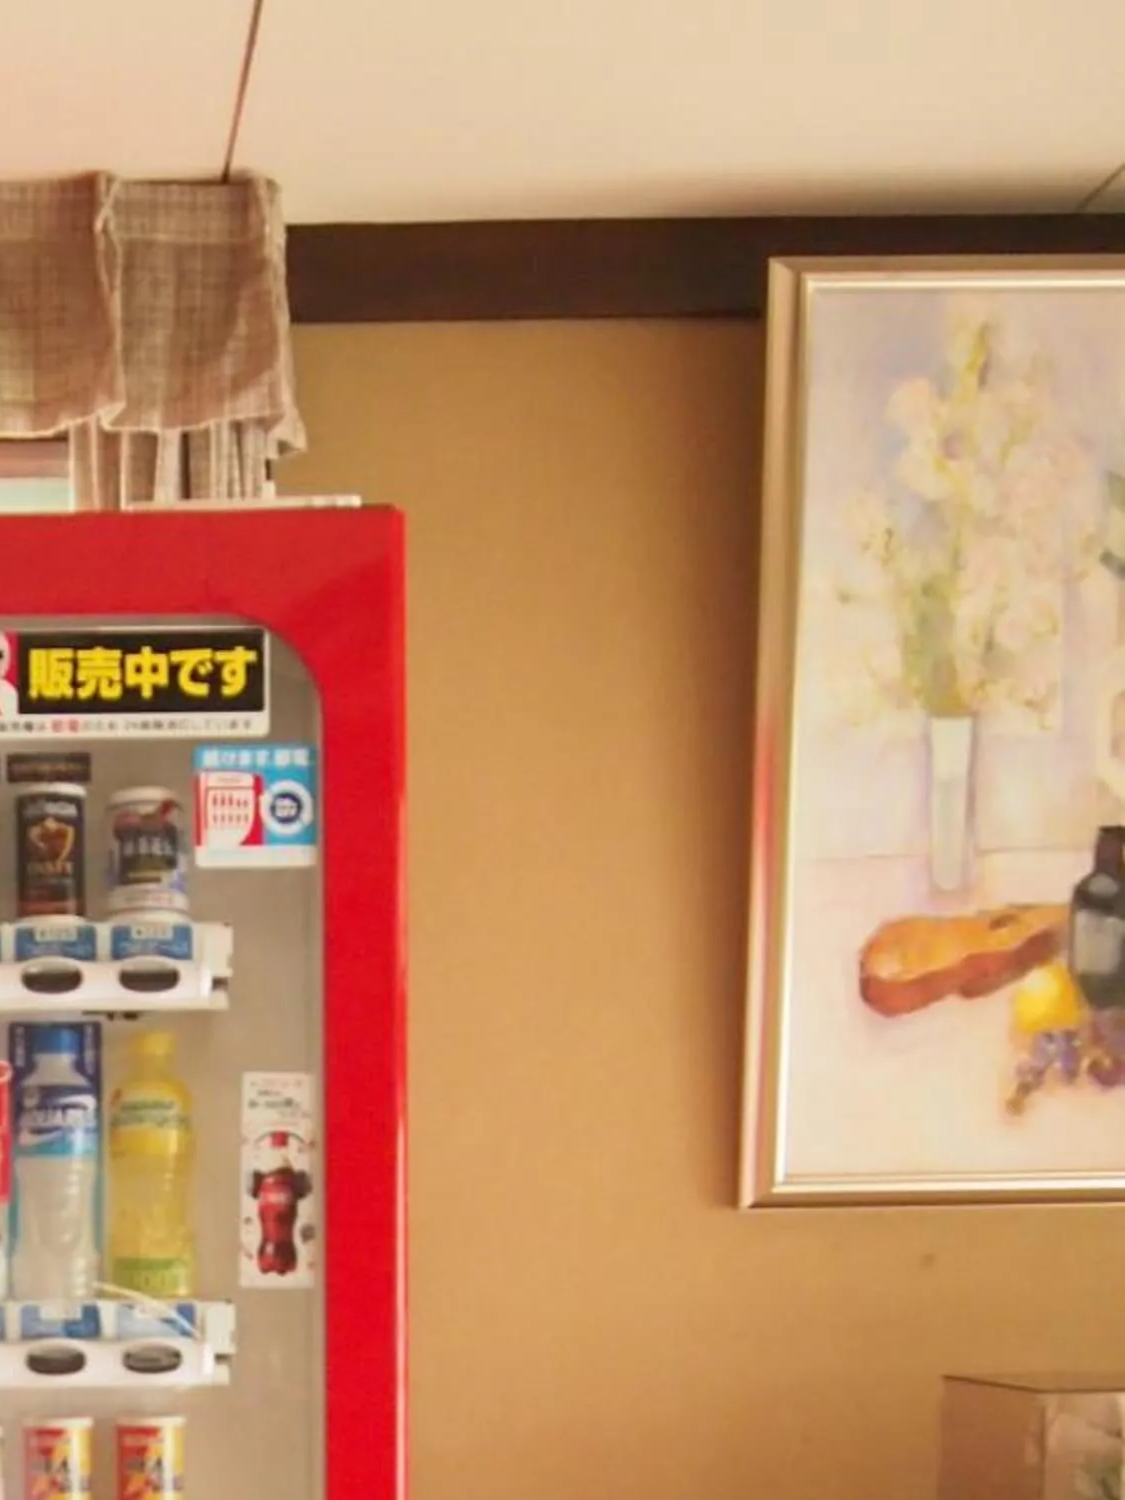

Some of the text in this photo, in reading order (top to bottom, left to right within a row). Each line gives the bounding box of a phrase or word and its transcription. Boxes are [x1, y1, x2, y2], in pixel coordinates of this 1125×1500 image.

[29, 646, 256, 699] 販売中です
